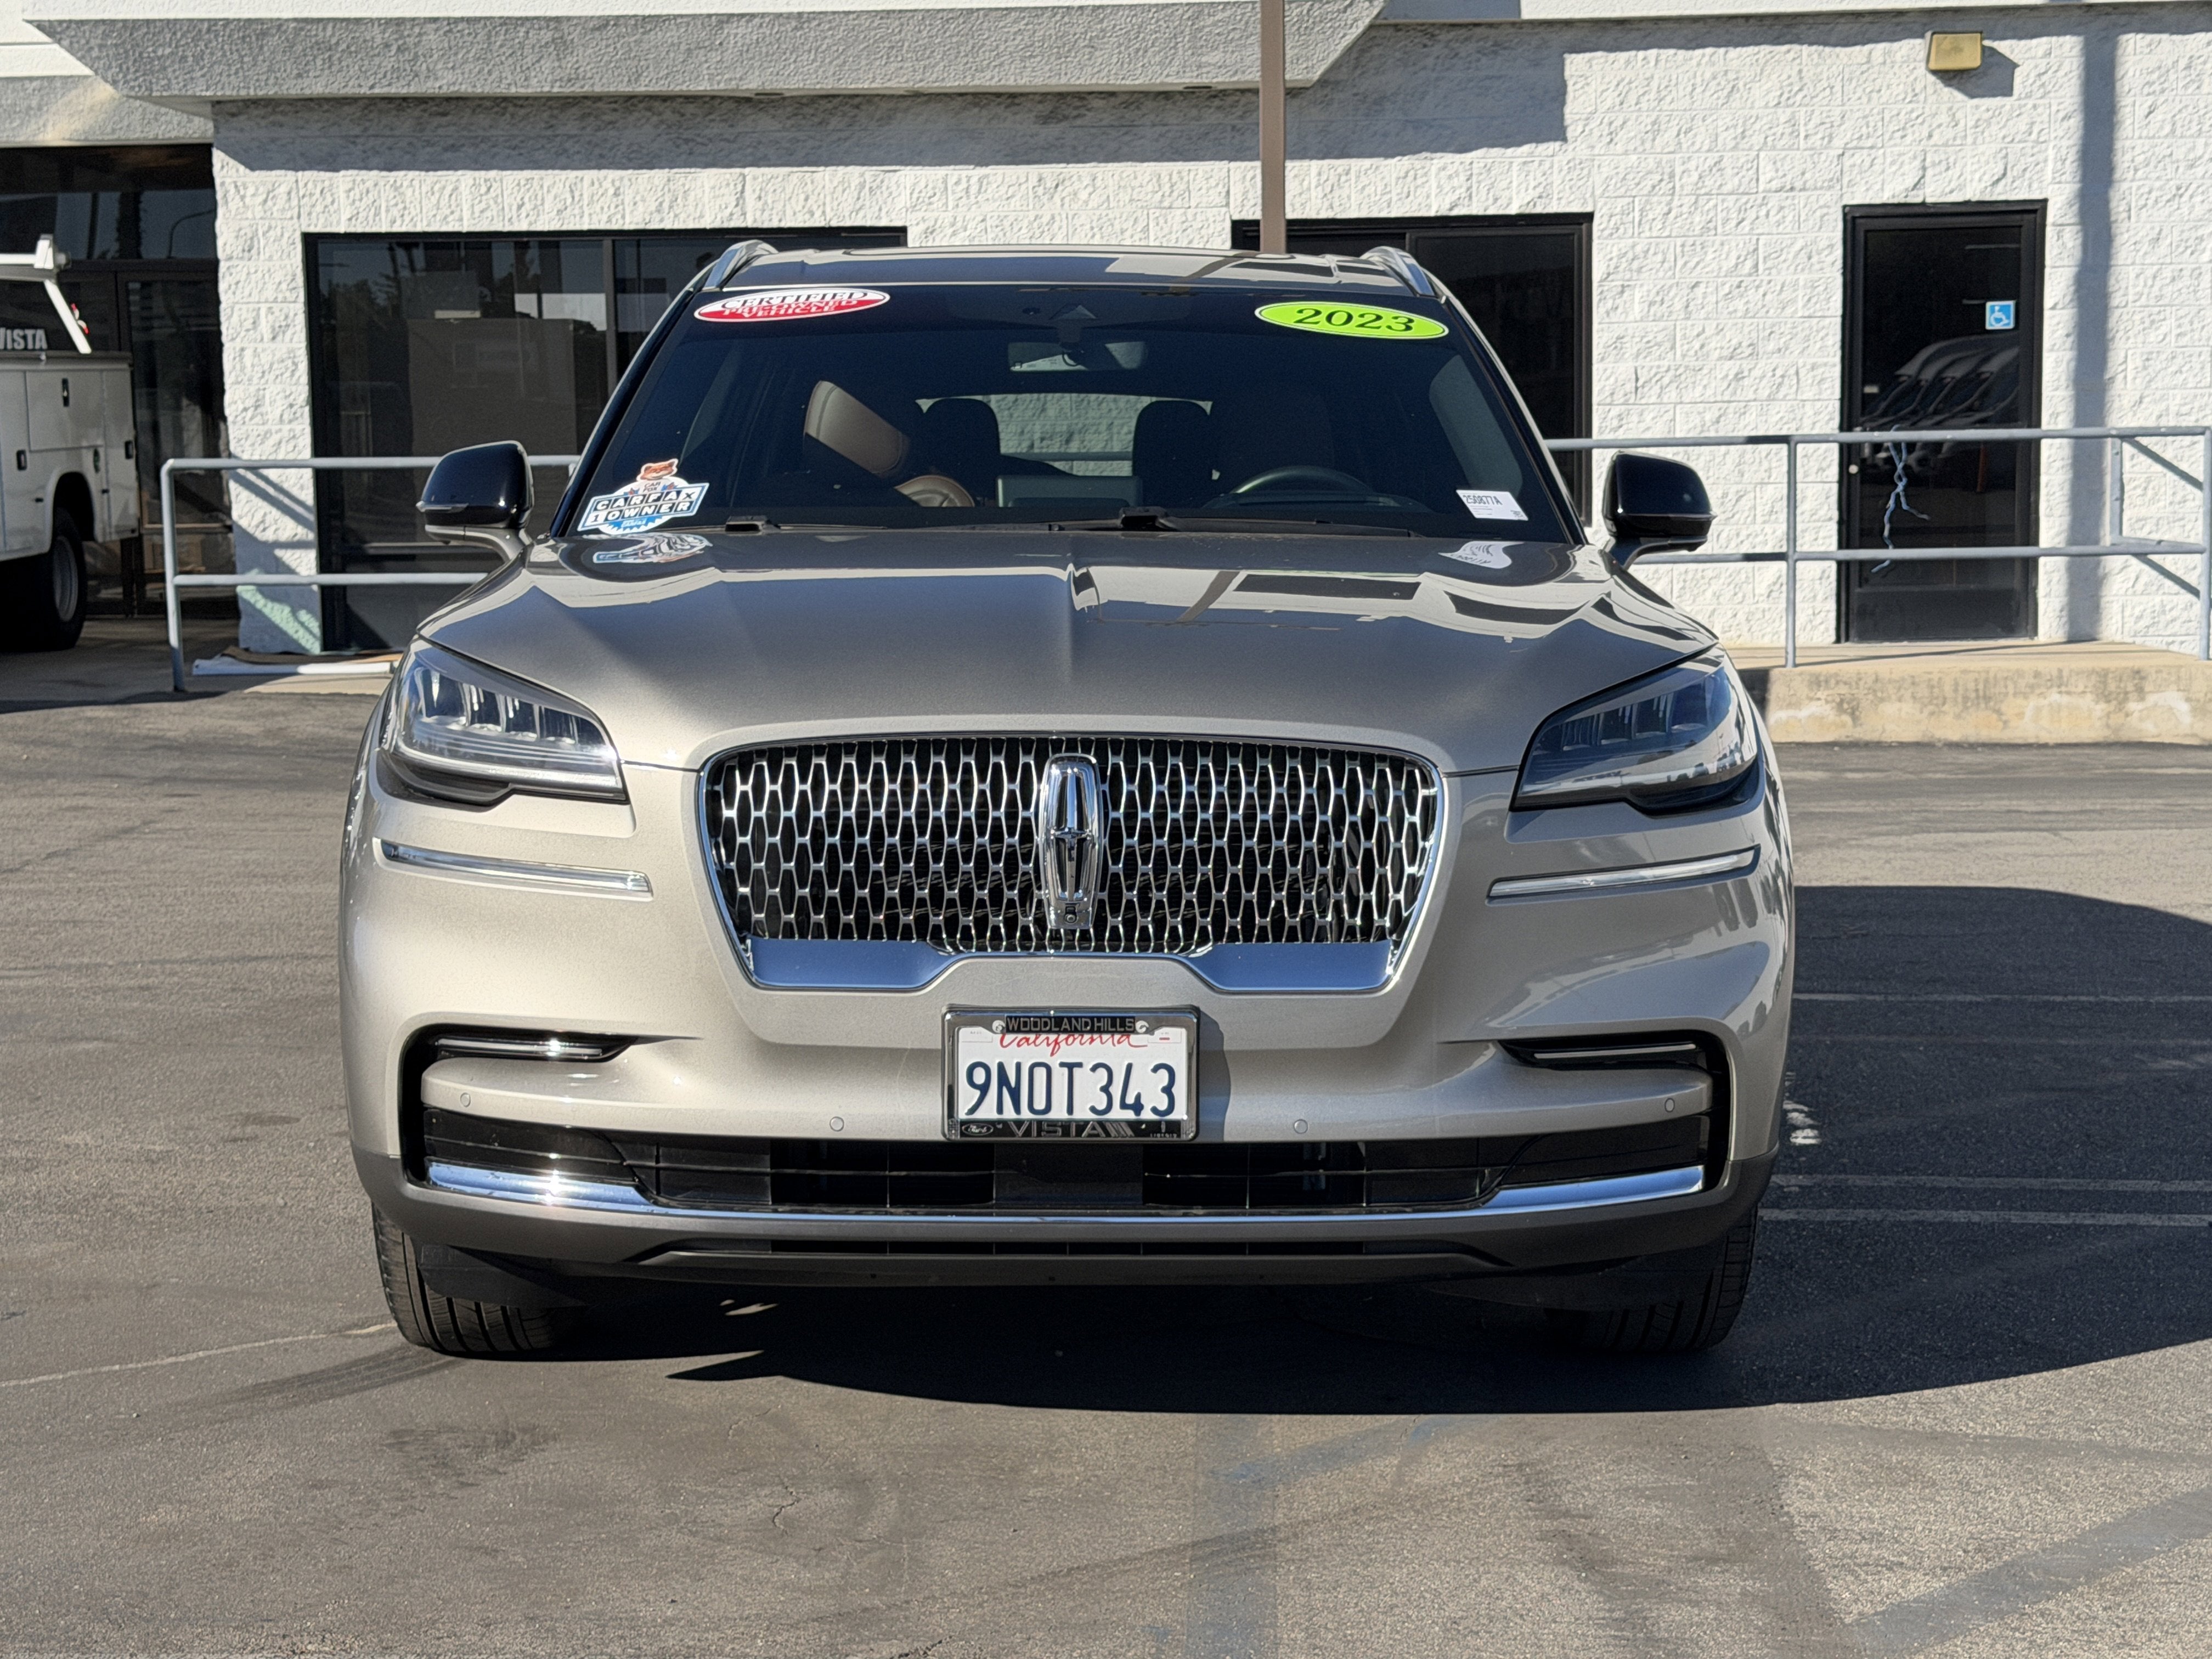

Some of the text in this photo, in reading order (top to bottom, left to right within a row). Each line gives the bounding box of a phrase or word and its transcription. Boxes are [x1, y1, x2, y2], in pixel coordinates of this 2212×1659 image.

[721, 292, 868, 309] CERTIFIED
[741, 305, 837, 318] VEHICLE
[1293, 307, 1415, 332] 2023
[596, 491, 695, 511] CARFAX
[590, 501, 691, 523] 1 OWNER
[1007, 1017, 1135, 1032] WOODLAND HILLS
[1000, 1033, 1148, 1057] California
[964, 1061, 1176, 1118] 9NOT343
[1008, 1120, 1106, 1137] VISTA
